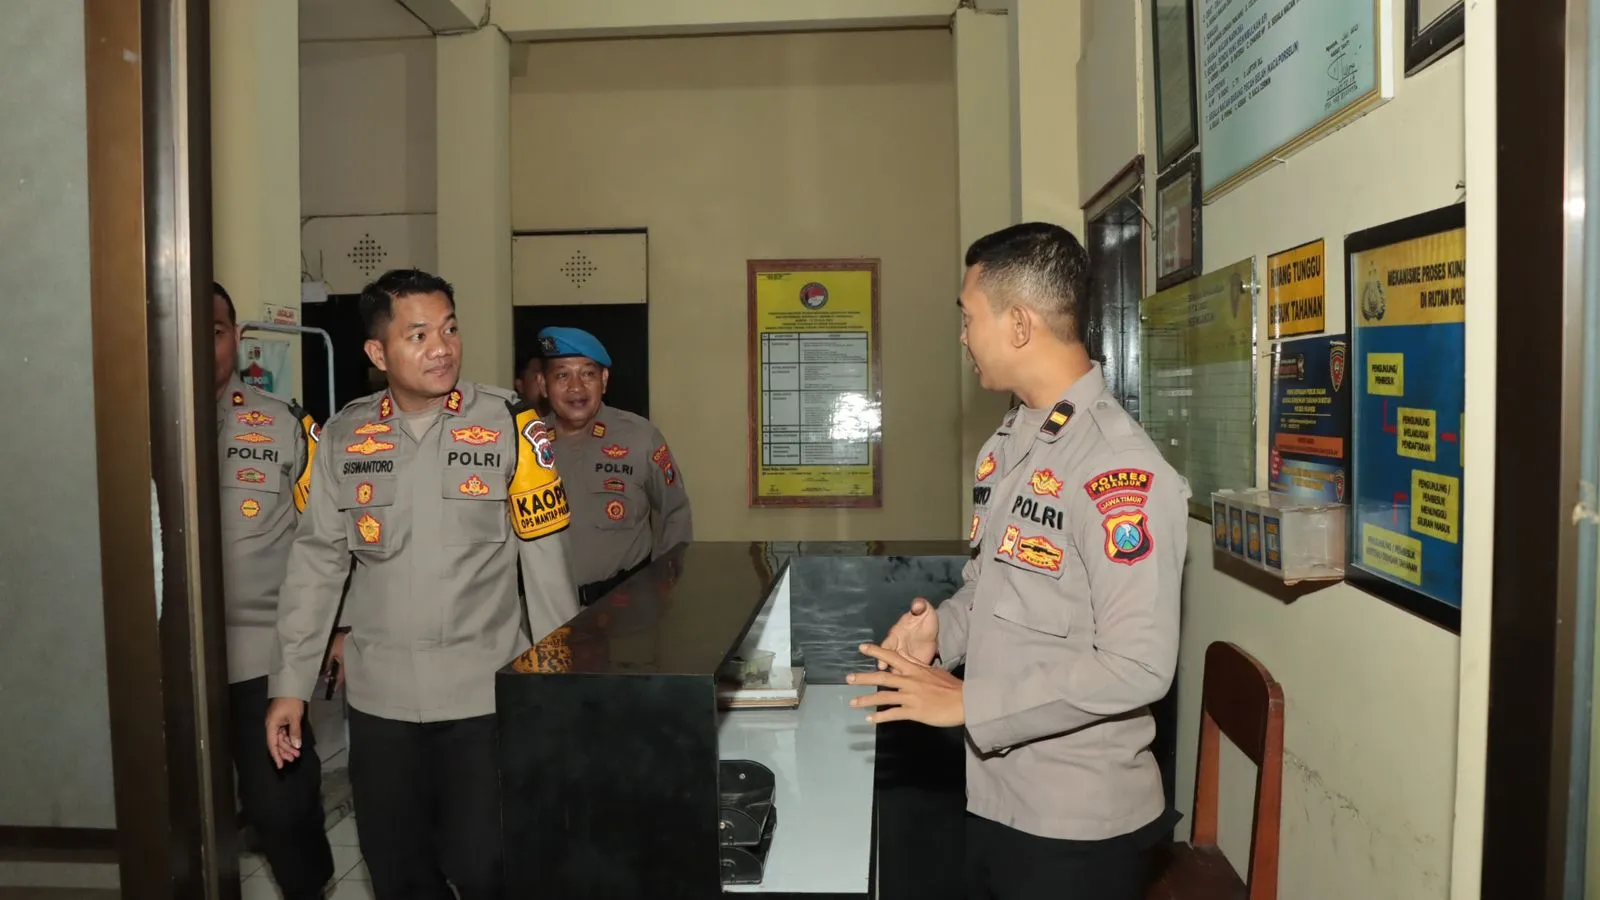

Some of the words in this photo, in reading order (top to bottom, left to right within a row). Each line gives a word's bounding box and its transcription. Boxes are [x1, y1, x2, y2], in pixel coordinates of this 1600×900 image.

[1292, 255, 1321, 282] TUNGGU
[1387, 266, 1421, 286] MEKANISME
[1422, 262, 1446, 282] PROSES
[1420, 291, 1427, 308] DI
[1428, 289, 1449, 308] RUTAN
[1270, 303, 1290, 325] BEUK
[1290, 296, 1323, 321] TAHANAN
[227, 447, 279, 462] POLRI
[447, 452, 501, 468] POLRI
[343, 460, 393, 475] SISWANTORO
[595, 463, 633, 475] POLRI
[1091, 472, 1147, 491] POLRES
[1098, 480, 1142, 492] NGANJUK
[1102, 497, 1121, 509] JAWA
[1120, 495, 1143, 504] TIMUR
[521, 517, 535, 529] OPS
[534, 509, 558, 525] MANTAP
[1011, 495, 1064, 530] POLRI
